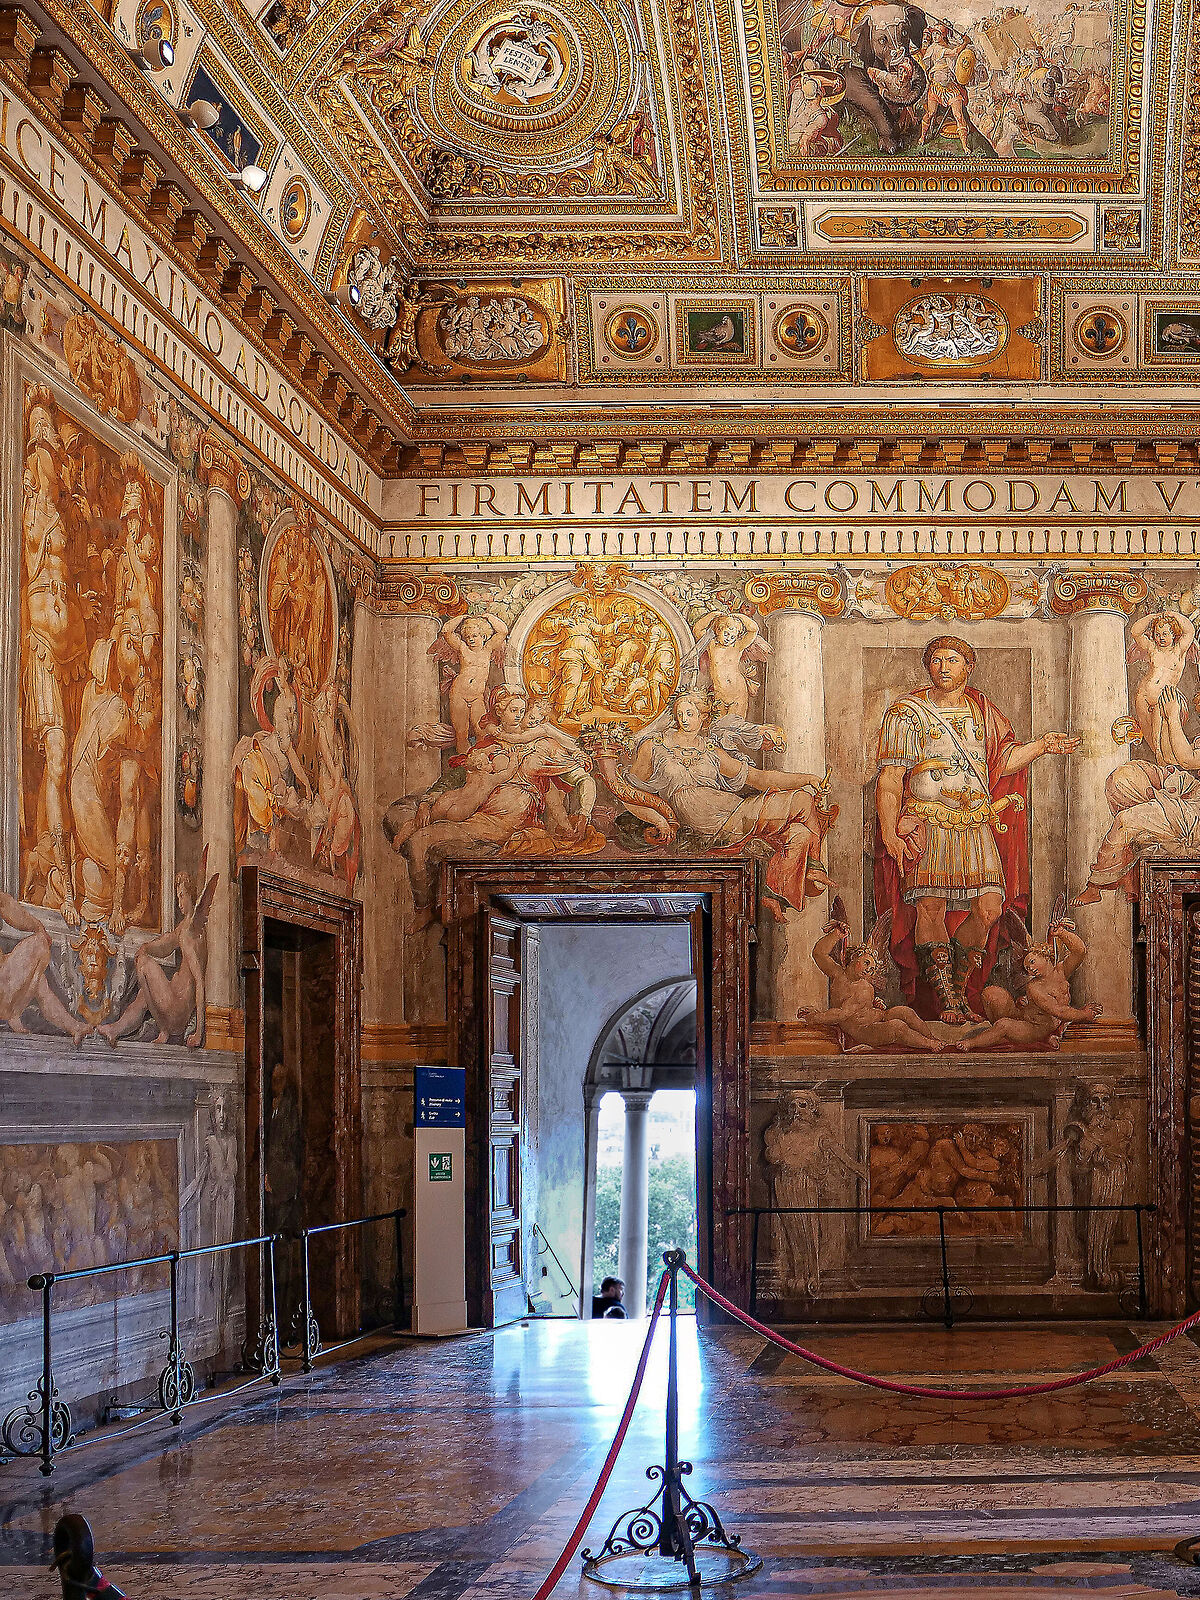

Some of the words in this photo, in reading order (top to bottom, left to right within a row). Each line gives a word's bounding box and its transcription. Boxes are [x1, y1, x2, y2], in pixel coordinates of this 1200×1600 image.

[503, 47, 538, 68] FESTINA
[503, 56, 531, 74] LENTE
[79, 174, 224, 357] MAXIMO
[232, 343, 271, 402] AD
[276, 382, 372, 507] SOLIDAM
[416, 480, 760, 517] FIRMITATEM
[784, 479, 1131, 516] COMMODAM
